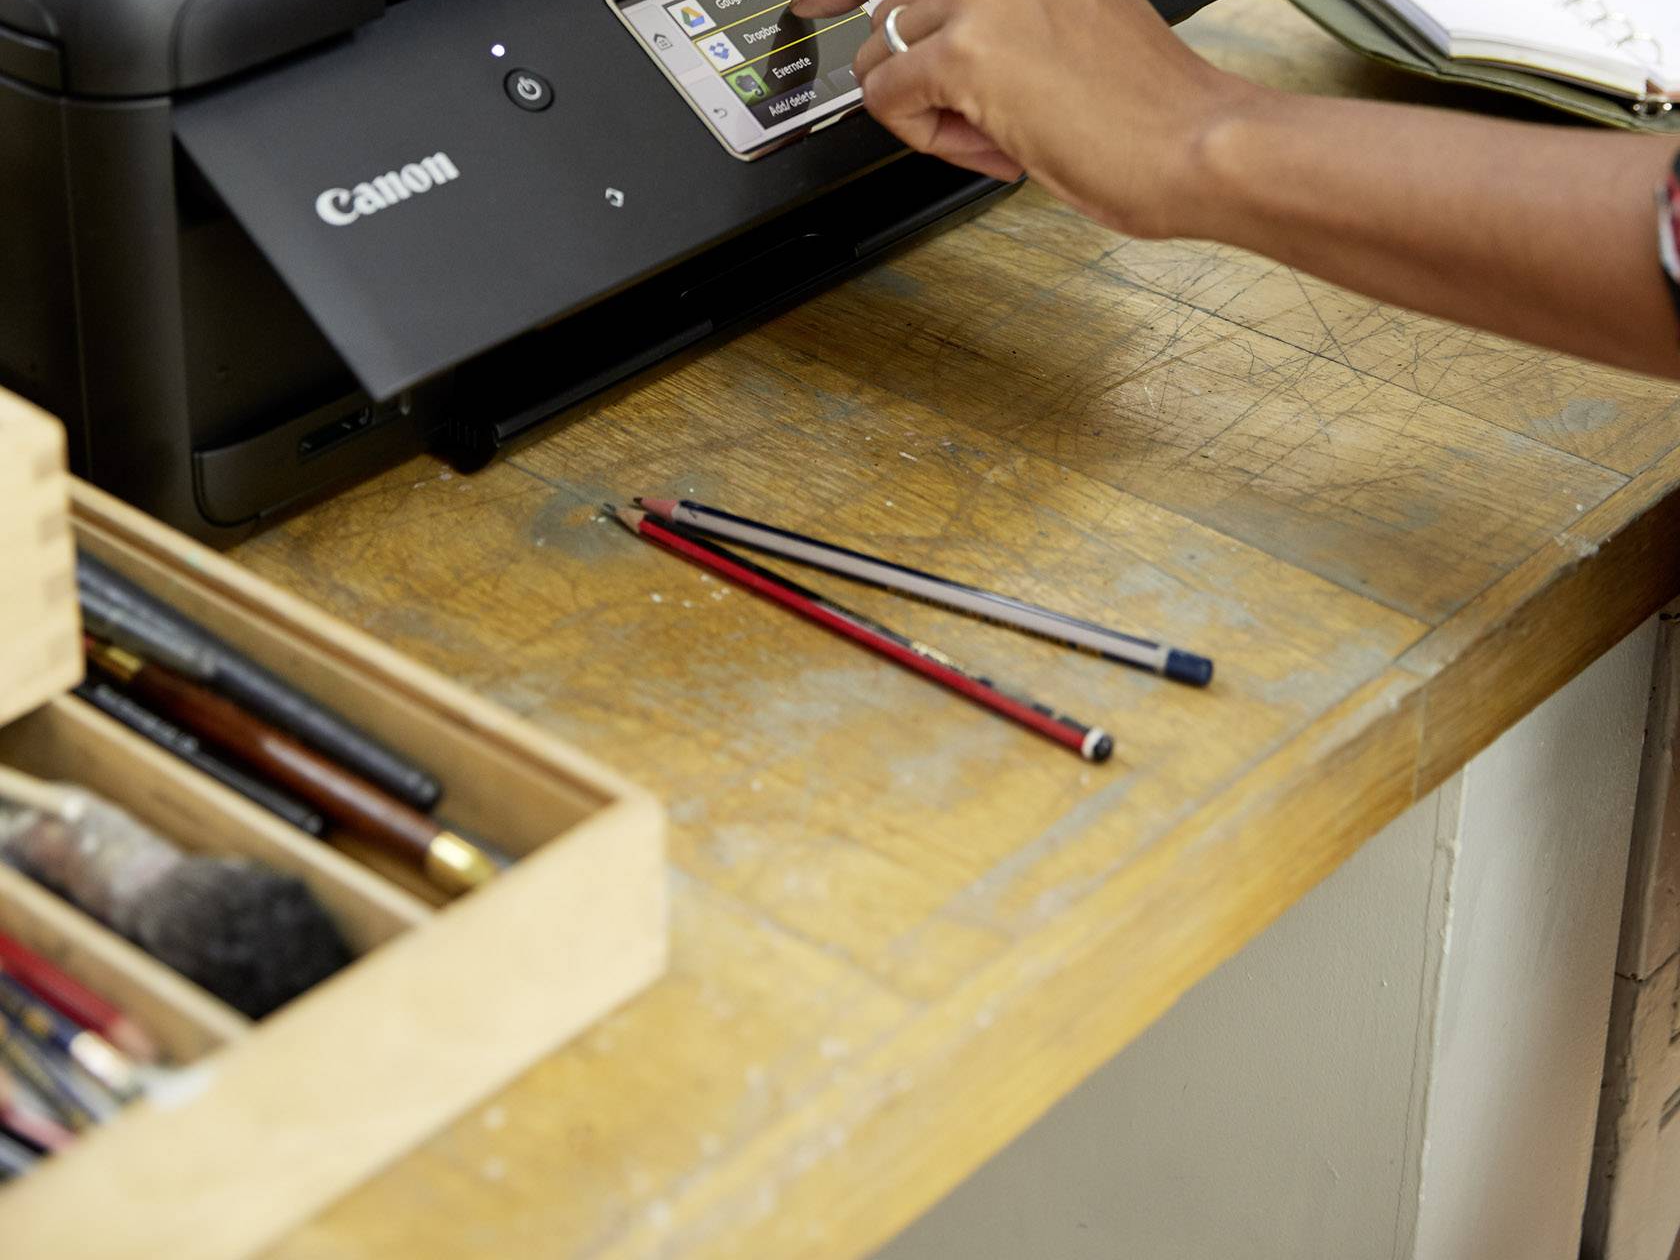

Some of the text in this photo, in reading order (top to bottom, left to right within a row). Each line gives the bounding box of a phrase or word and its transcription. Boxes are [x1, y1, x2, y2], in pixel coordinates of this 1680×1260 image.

[743, 23, 781, 45] Dropbox
[772, 56, 812, 79] Evernote
[768, 90, 816, 117] Add/delete
[316, 151, 460, 226] Canon
